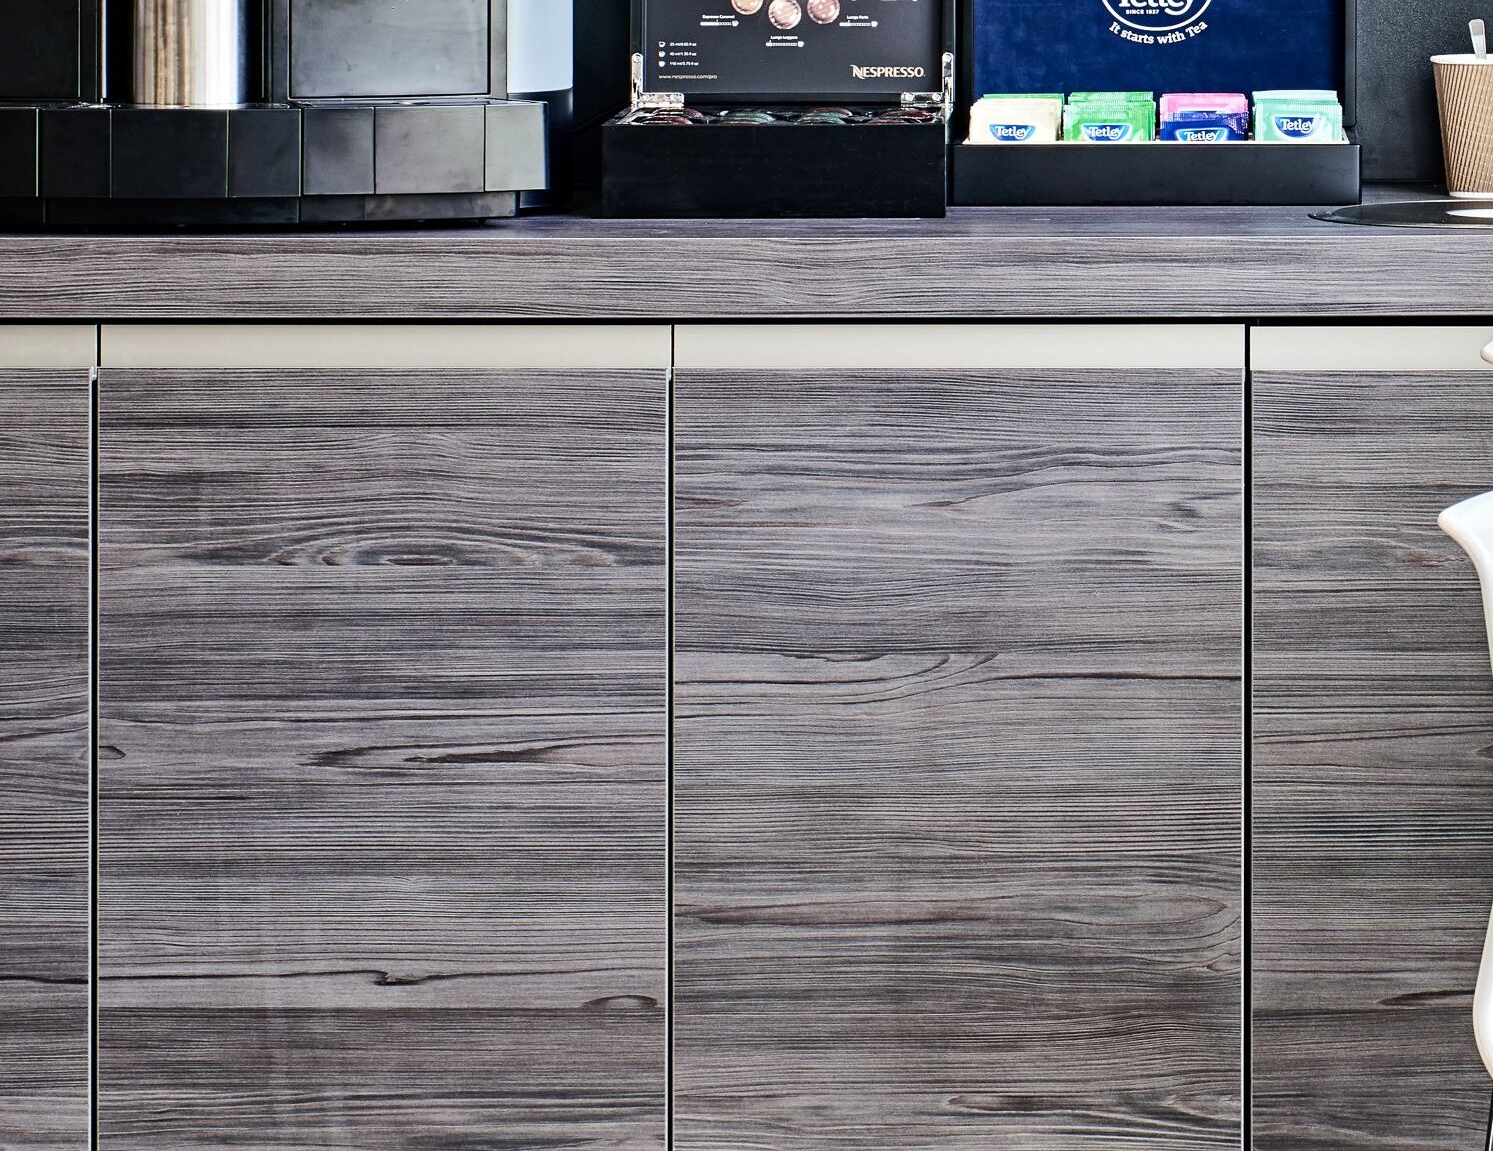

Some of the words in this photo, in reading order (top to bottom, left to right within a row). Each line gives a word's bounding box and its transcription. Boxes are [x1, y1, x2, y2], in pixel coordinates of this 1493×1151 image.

[1108, 21, 1121, 35] It
[1120, 29, 1155, 45] starts
[1156, 30, 1187, 45] with
[1185, 21, 1208, 38] Tea
[850, 64, 925, 80] NESPRESSO
[995, 125, 1032, 140] Tetley
[1088, 125, 1127, 140] Tetley
[1279, 118, 1315, 135] Tetley
[1183, 130, 1219, 142] Tetley
